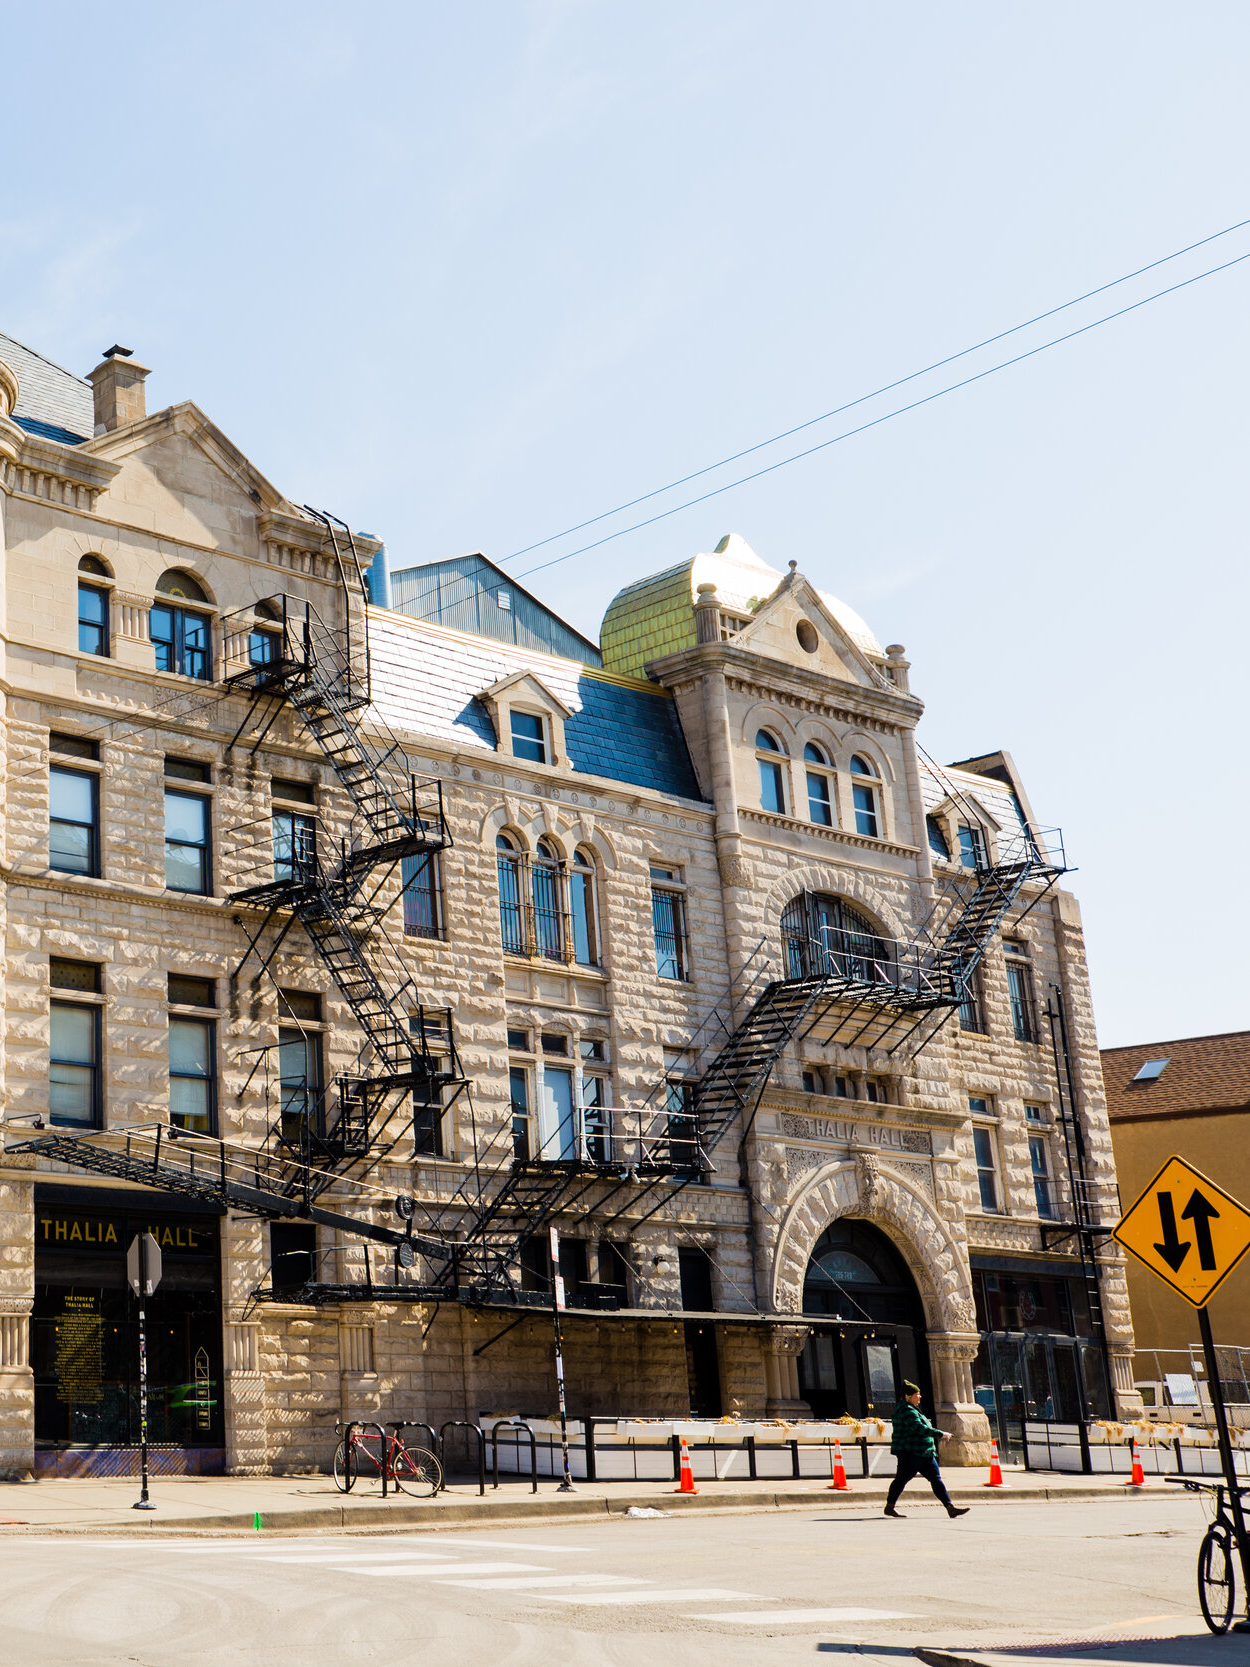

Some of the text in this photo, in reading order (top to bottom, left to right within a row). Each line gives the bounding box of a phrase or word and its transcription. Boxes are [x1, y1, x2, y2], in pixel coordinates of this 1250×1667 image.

[804, 1118, 909, 1147] THALIA HALL
[40, 1219, 199, 1247] THALIA HALL
